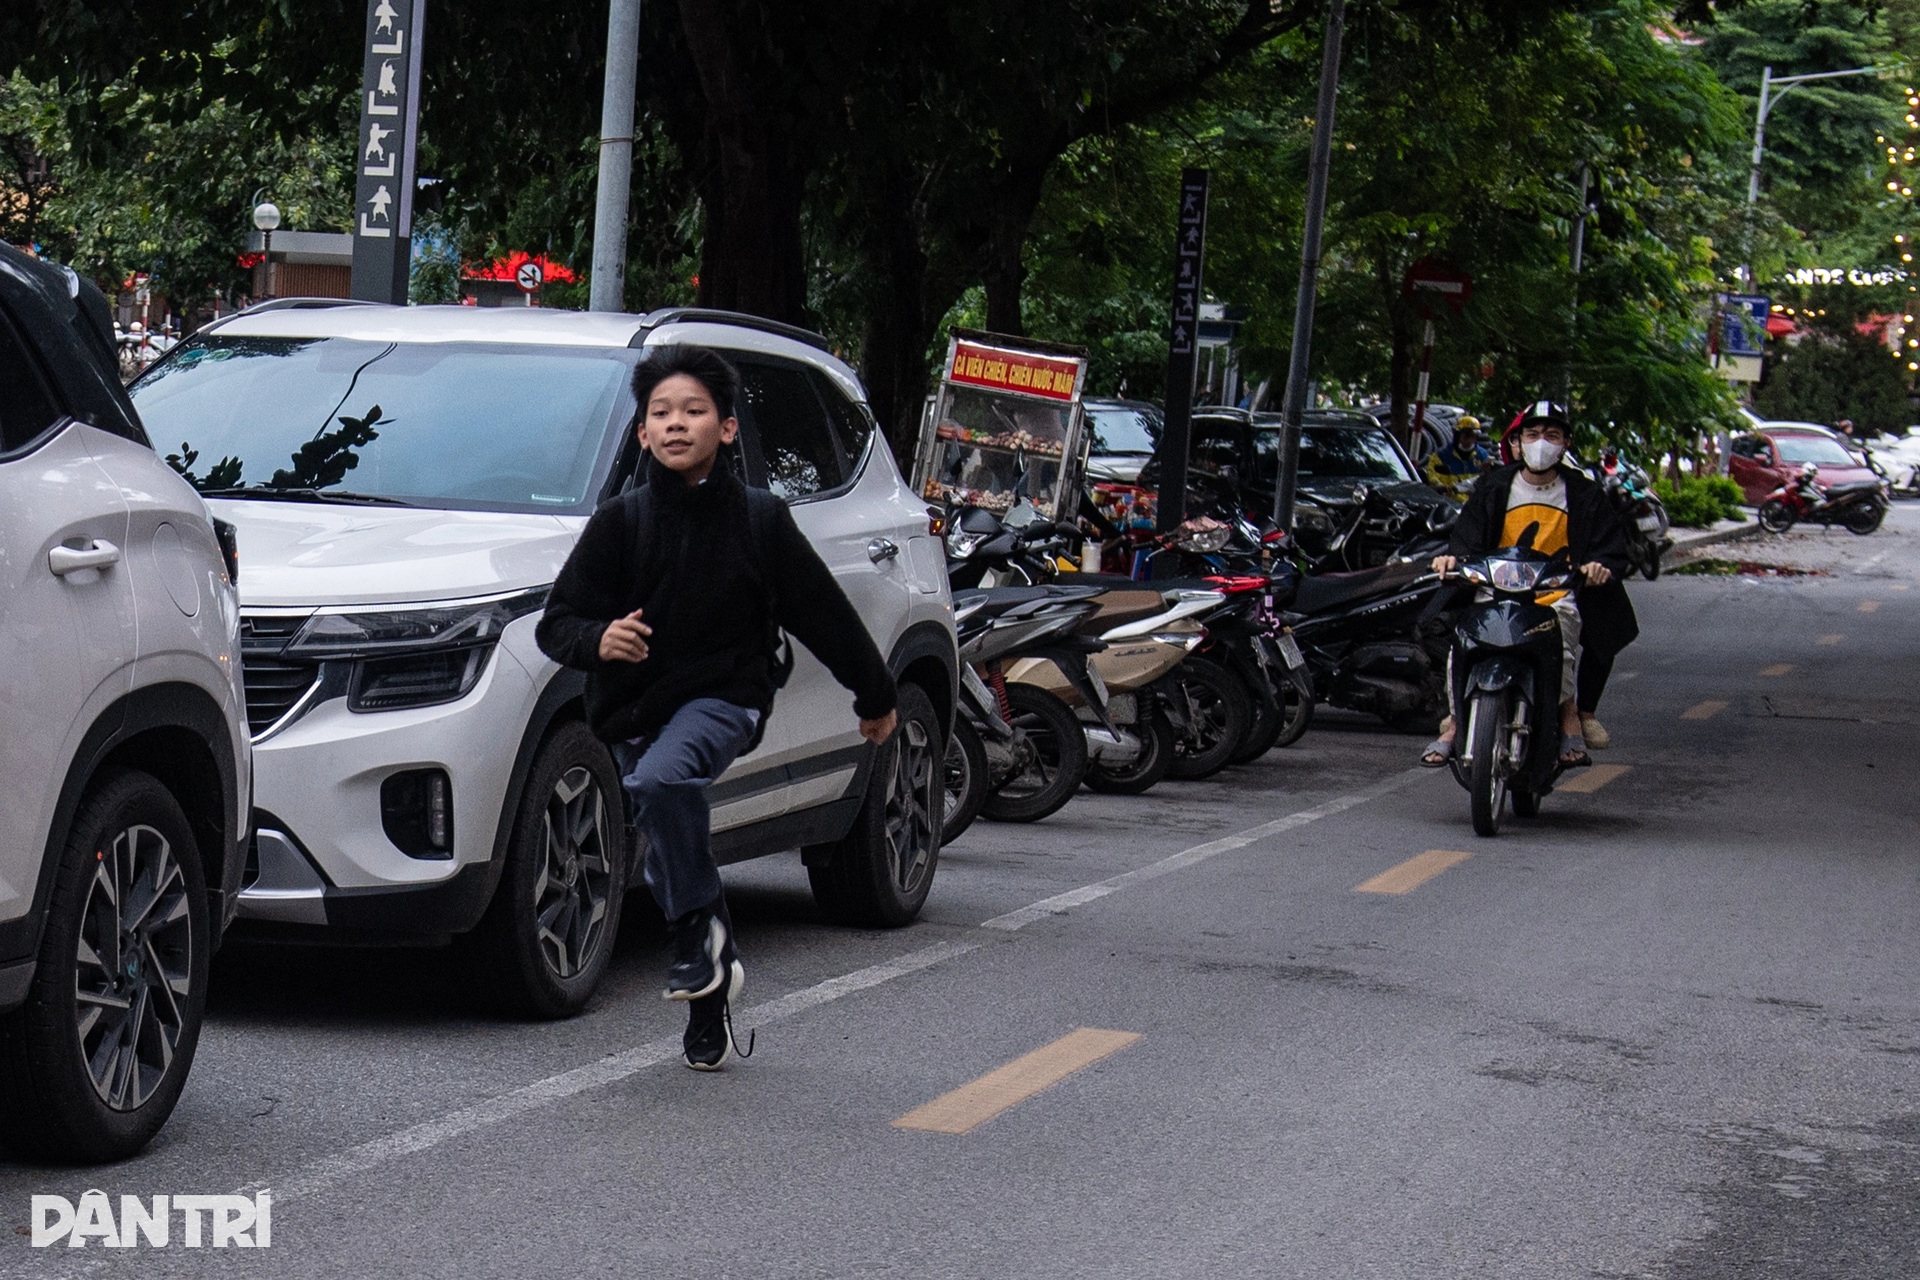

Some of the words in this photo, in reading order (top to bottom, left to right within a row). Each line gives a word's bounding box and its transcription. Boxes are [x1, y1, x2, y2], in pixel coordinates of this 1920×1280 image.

[954, 352, 967, 375] CÁ
[967, 355, 985, 378] VIÊN
[984, 358, 1008, 385] CHIÊN,
[1009, 362, 1033, 387] CHIÊN
[1032, 365, 1054, 390] NƯỚC
